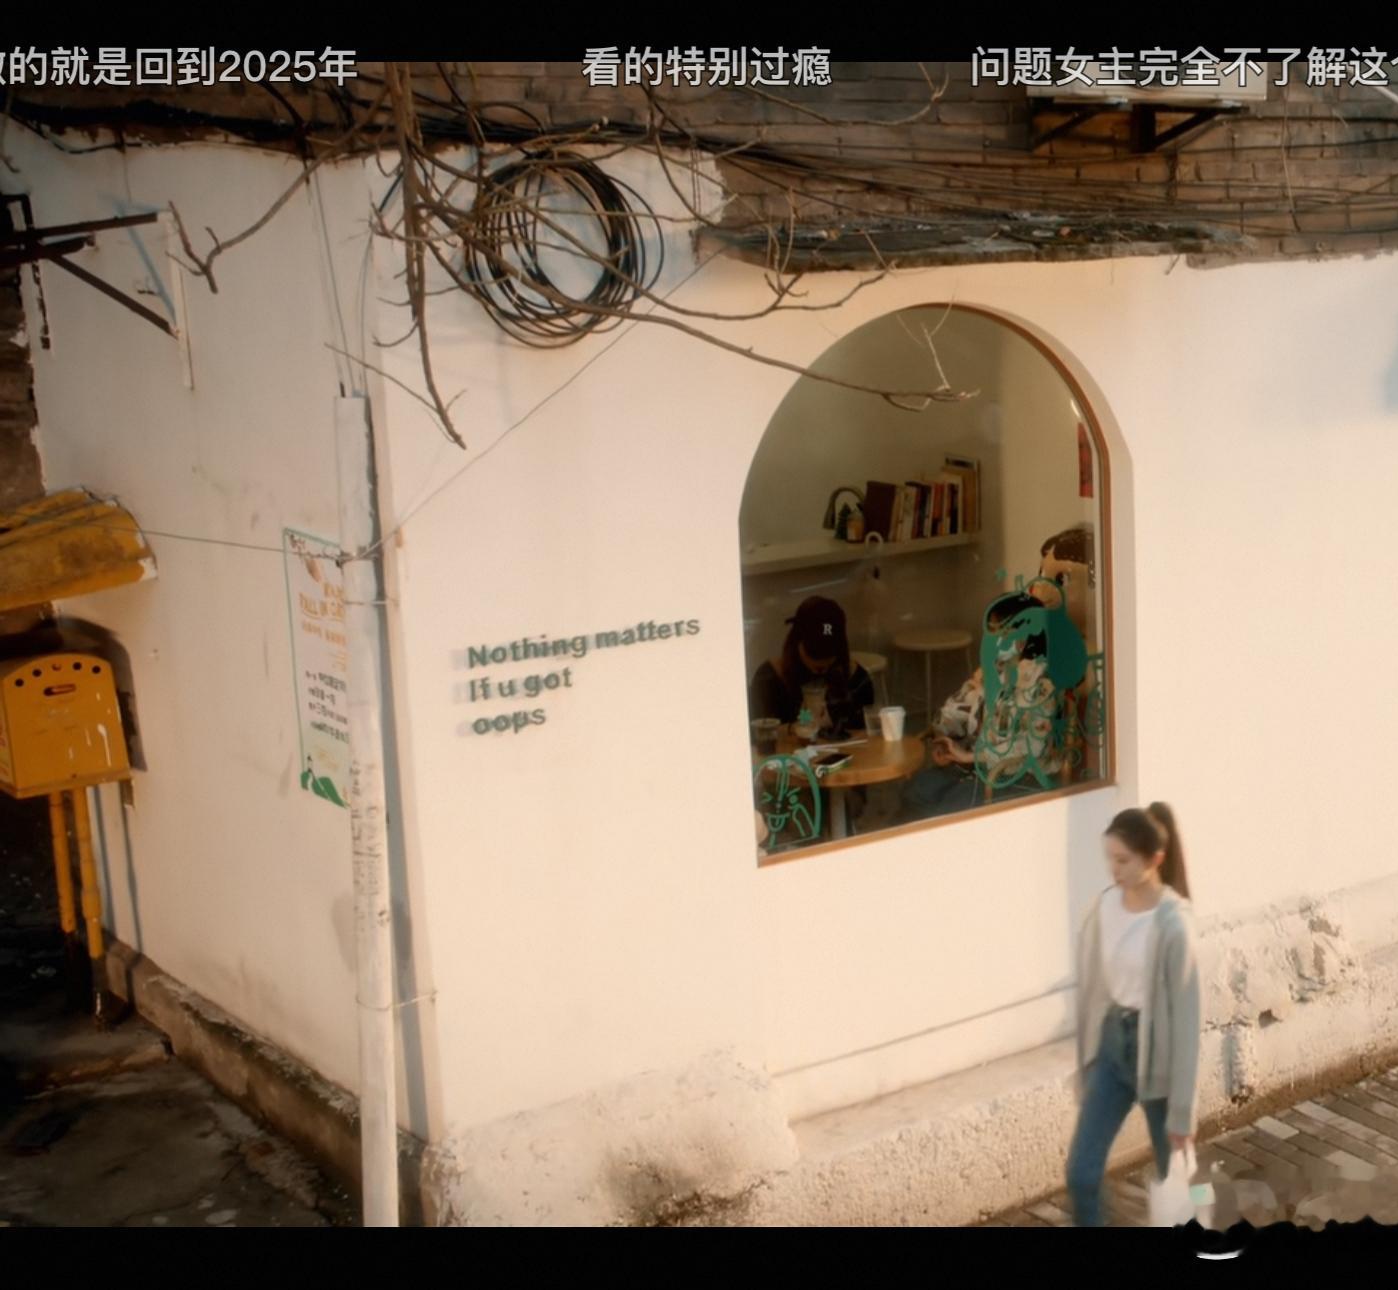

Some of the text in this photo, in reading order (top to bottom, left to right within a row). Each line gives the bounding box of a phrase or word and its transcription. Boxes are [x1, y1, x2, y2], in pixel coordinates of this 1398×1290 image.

[467, 618, 701, 669] Nothing matters
[823, 623, 833, 636] R
[469, 667, 573, 702] If u got
[472, 707, 547, 735] oops
